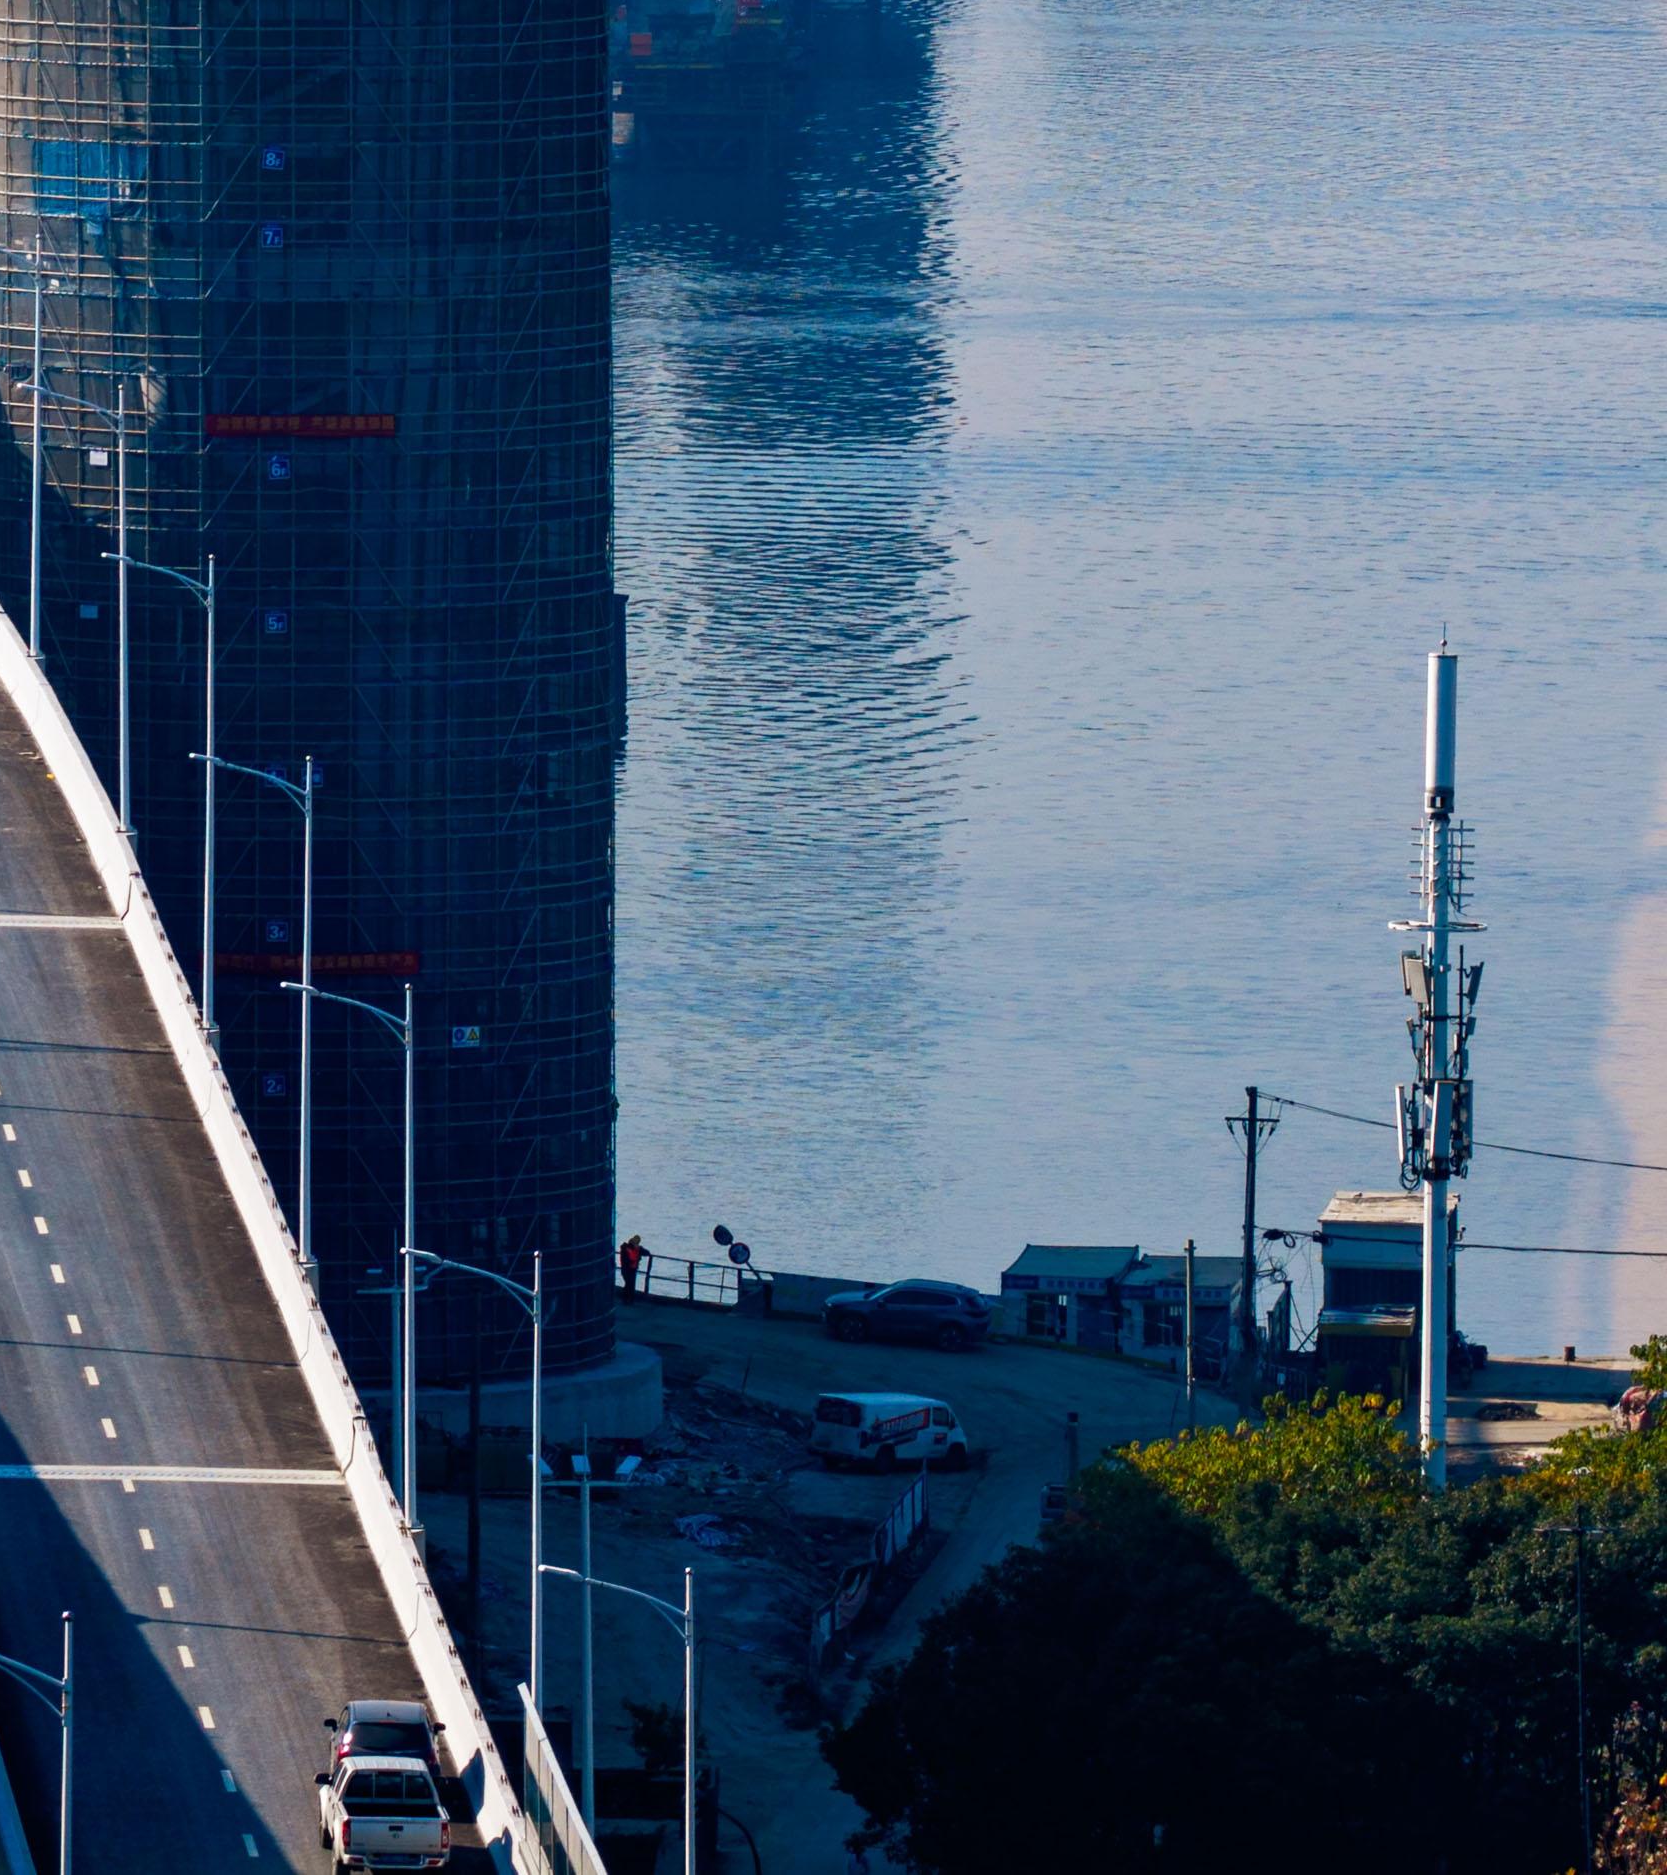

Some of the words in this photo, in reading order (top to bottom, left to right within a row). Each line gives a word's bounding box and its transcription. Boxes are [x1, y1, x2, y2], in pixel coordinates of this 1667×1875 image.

[265, 152, 281, 167] 8F
[264, 230, 280, 245] 7F
[271, 463, 286, 477] 6F
[268, 616, 284, 631] 5F
[269, 925, 284, 939] 3F
